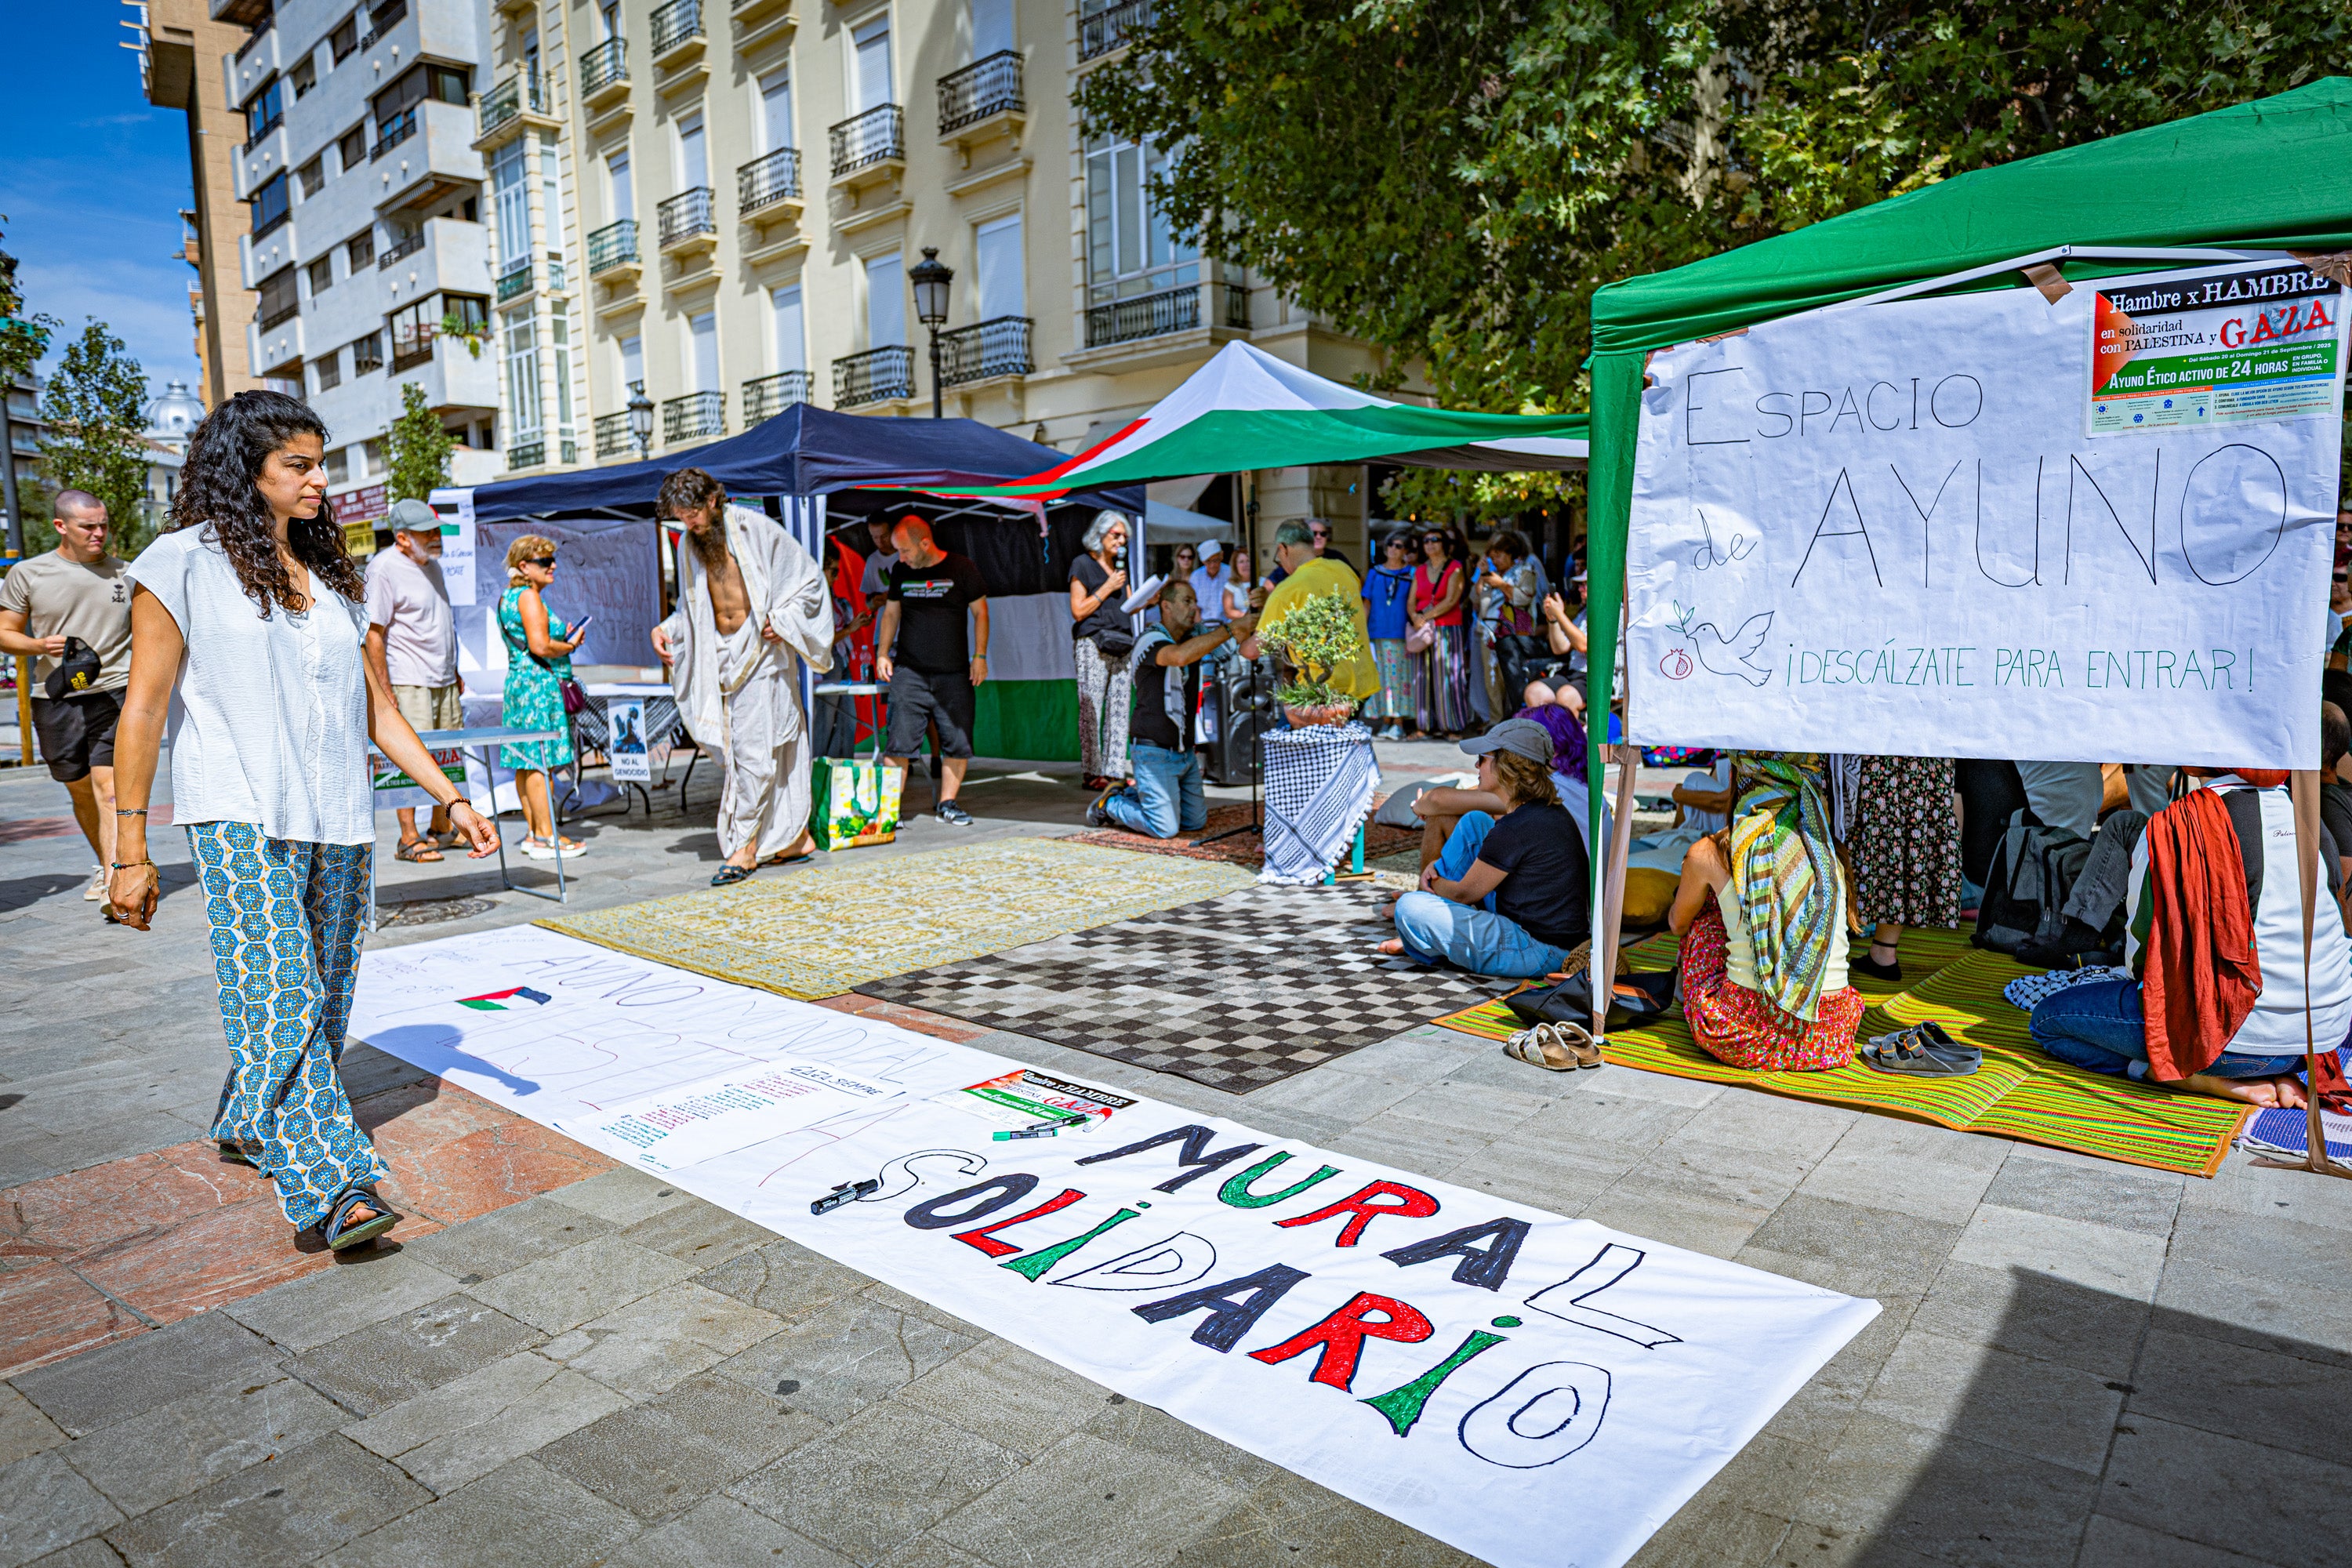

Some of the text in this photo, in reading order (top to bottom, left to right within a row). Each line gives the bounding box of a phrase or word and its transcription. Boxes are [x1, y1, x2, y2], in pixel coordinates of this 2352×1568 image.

[2109, 271, 2329, 314] Hambre x HAMBRE
[2101, 320, 2183, 339] en solidaridad
[2220, 299, 2335, 349] GAZA
[2100, 332, 2217, 354] con PALESTINA y
[2199, 354, 2220, 362] Sábado
[2279, 345, 2312, 354] Septiembre
[2178, 368, 2213, 383] ACTIVO
[2216, 366, 2229, 379] DE
[2231, 359, 2251, 377] 24
[2255, 360, 2288, 376] HORAS
[2292, 365, 2322, 373] INDIVIDUAL
[1686, 367, 1983, 446] ESPACIO
[1693, 443, 2286, 588] de AYUNO
[1788, 637, 2255, 692] ¡DESCÁLZATE PARA ENTRAR!
[790, 1066, 833, 1080] GAZA
[829, 1078, 884, 1095] SIEMPRE
[1044, 1097, 1102, 1116] GAZA
[1063, 1084, 1129, 1106] HAMBRE
[1075, 1124, 1683, 1349] MURAL
